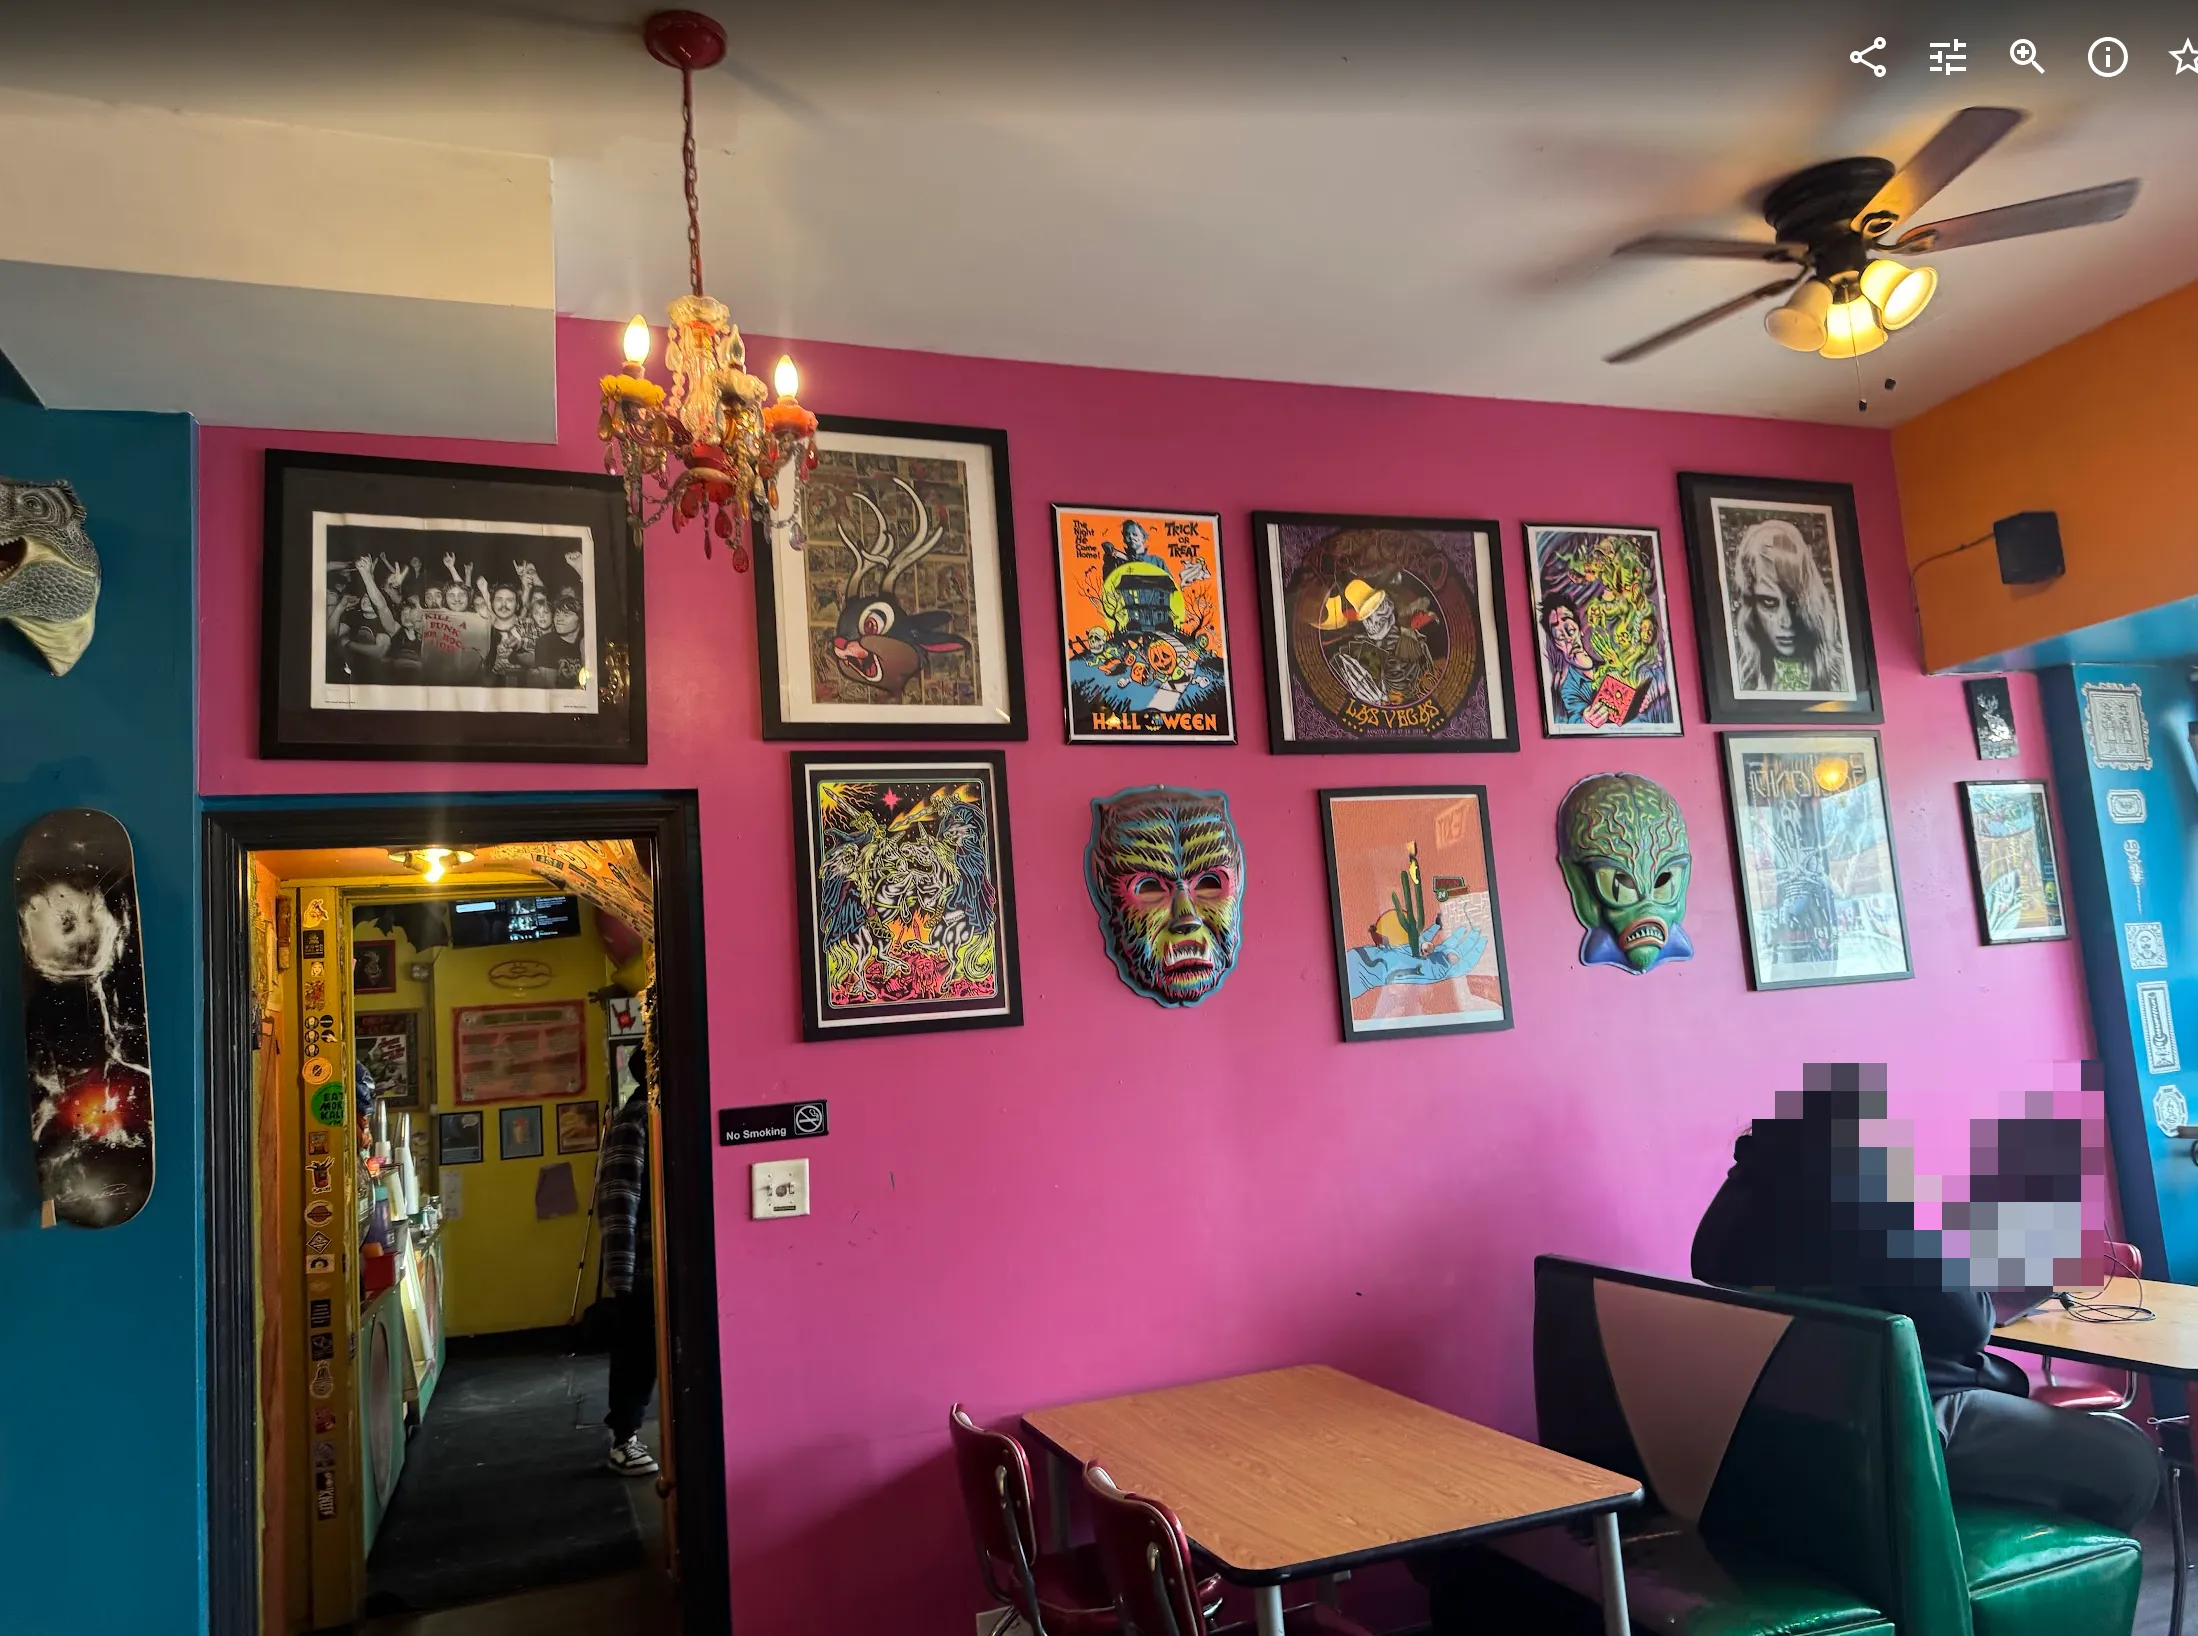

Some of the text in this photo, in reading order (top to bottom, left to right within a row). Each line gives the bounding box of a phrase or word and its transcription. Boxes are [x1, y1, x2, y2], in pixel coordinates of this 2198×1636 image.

[1073, 520, 1087, 529] The
[1165, 522, 1199, 536] TRICK
[1074, 527, 1094, 536] Night
[1076, 535, 1088, 544] He
[1178, 536, 1190, 544] OR
[1076, 543, 1097, 552] Came
[1168, 544, 1200, 558] TREAT
[1076, 550, 1100, 560] Home!
[1346, 698, 1440, 728] LAS VEGAS
[319, 1101, 343, 1111] MOR
[726, 1127, 787, 1141] No Smoking
